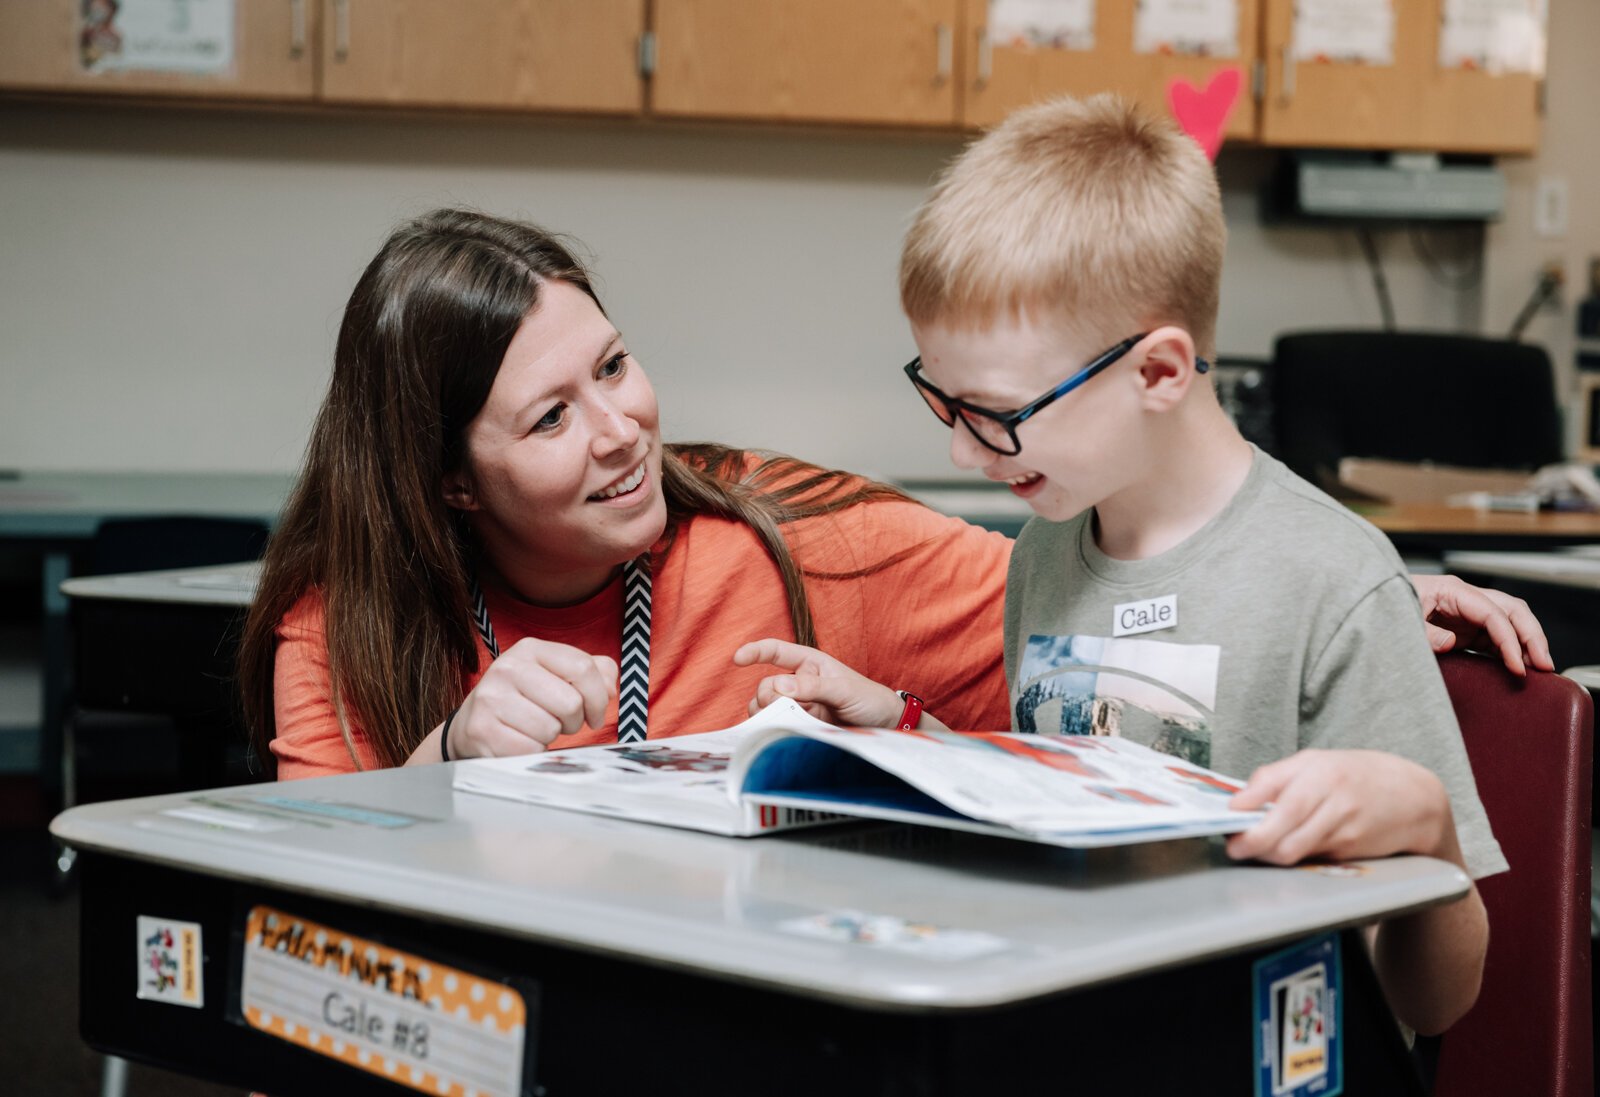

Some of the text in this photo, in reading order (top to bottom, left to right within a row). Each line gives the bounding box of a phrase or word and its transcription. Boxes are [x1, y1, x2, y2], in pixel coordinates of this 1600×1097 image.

[1120, 603, 1171, 630] Cale
[322, 992, 430, 1060] Cale #8
